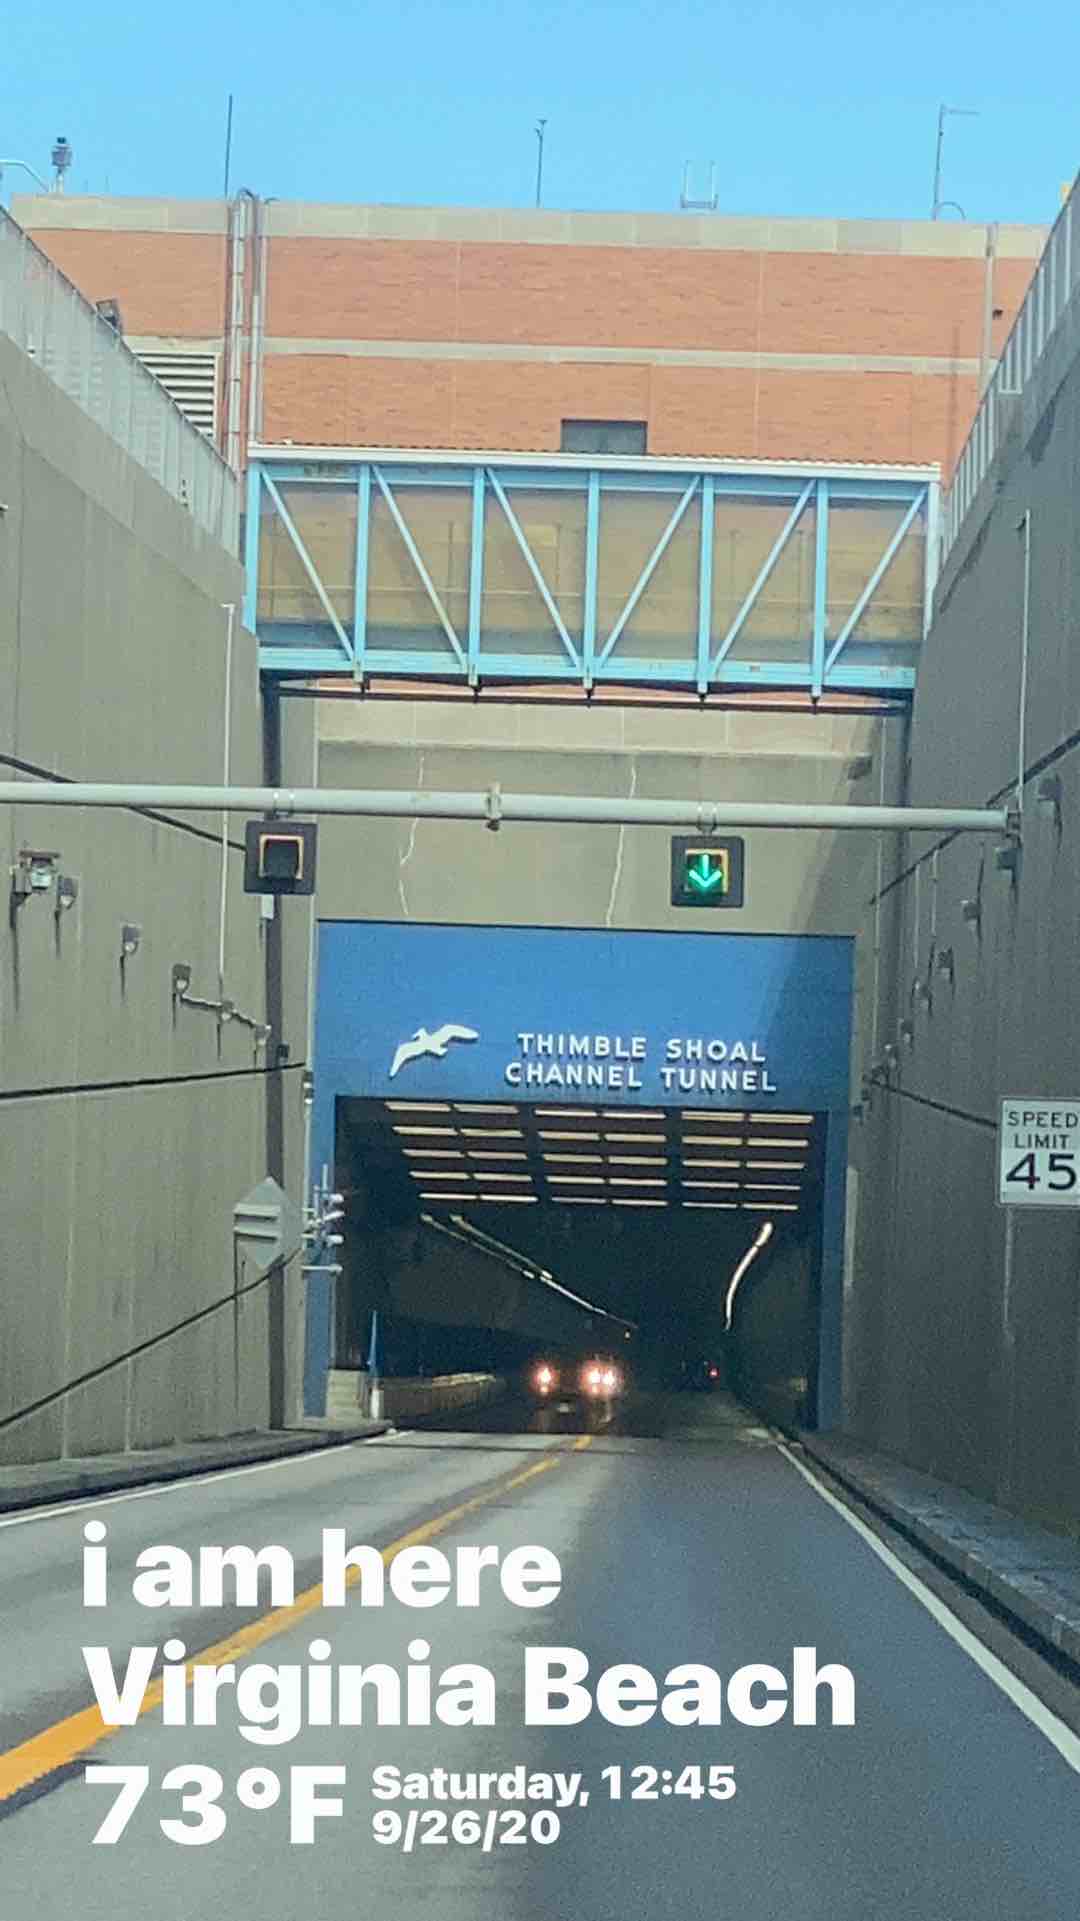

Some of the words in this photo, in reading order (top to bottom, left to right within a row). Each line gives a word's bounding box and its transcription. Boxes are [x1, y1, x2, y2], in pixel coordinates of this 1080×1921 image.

[517, 1032, 647, 1058] THIMBLE
[666, 1038, 766, 1062] SHOAL
[505, 1061, 643, 1088] CHANNEL
[660, 1066, 777, 1092] TUNNEL
[1007, 1111, 1079, 1129] SPEED
[1014, 1133, 1072, 1149] LIMIT
[1006, 1152, 1077, 1191] 45
